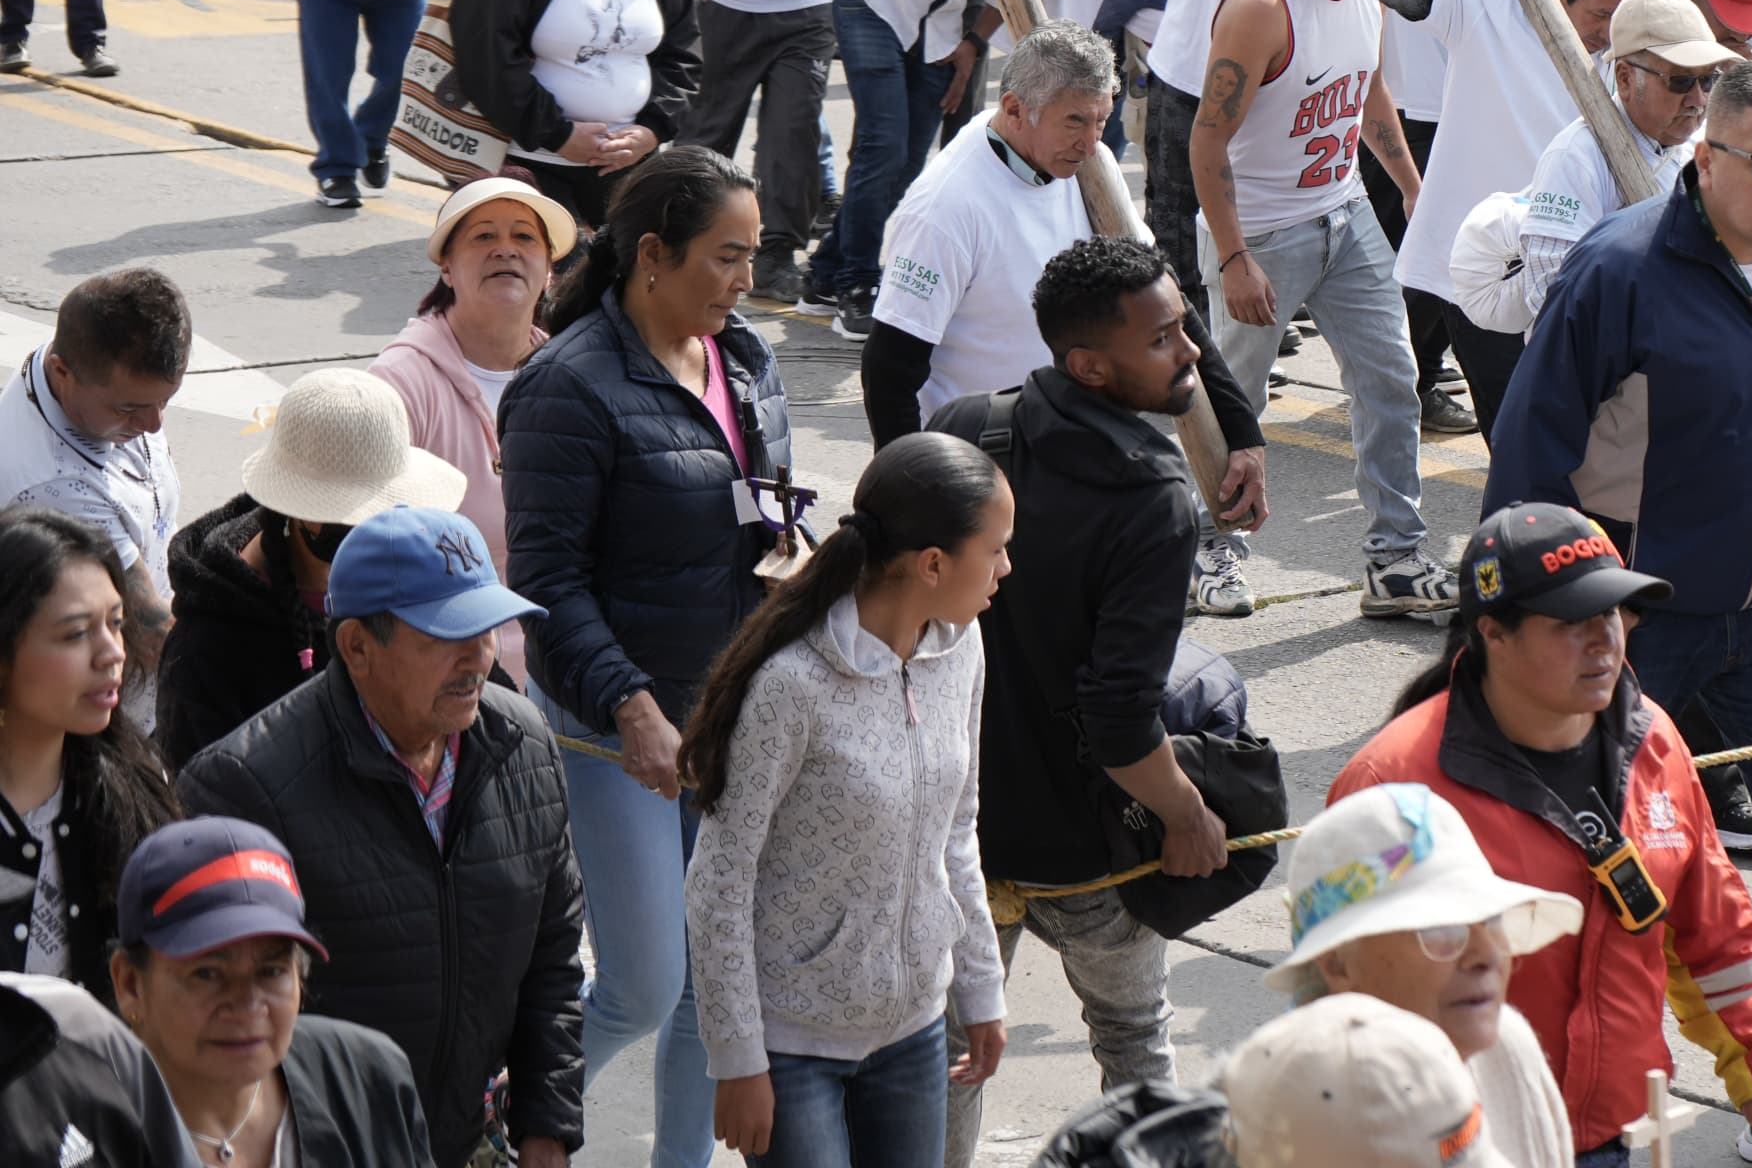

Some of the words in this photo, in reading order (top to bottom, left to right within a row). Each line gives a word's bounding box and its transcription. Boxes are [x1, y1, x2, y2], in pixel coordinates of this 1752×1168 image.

[402, 104, 479, 155] ECUADOR
[1296, 123, 1361, 188] 23
[1557, 195, 1581, 211] SAS
[915, 266, 940, 286] SAS
[435, 529, 484, 577] NY
